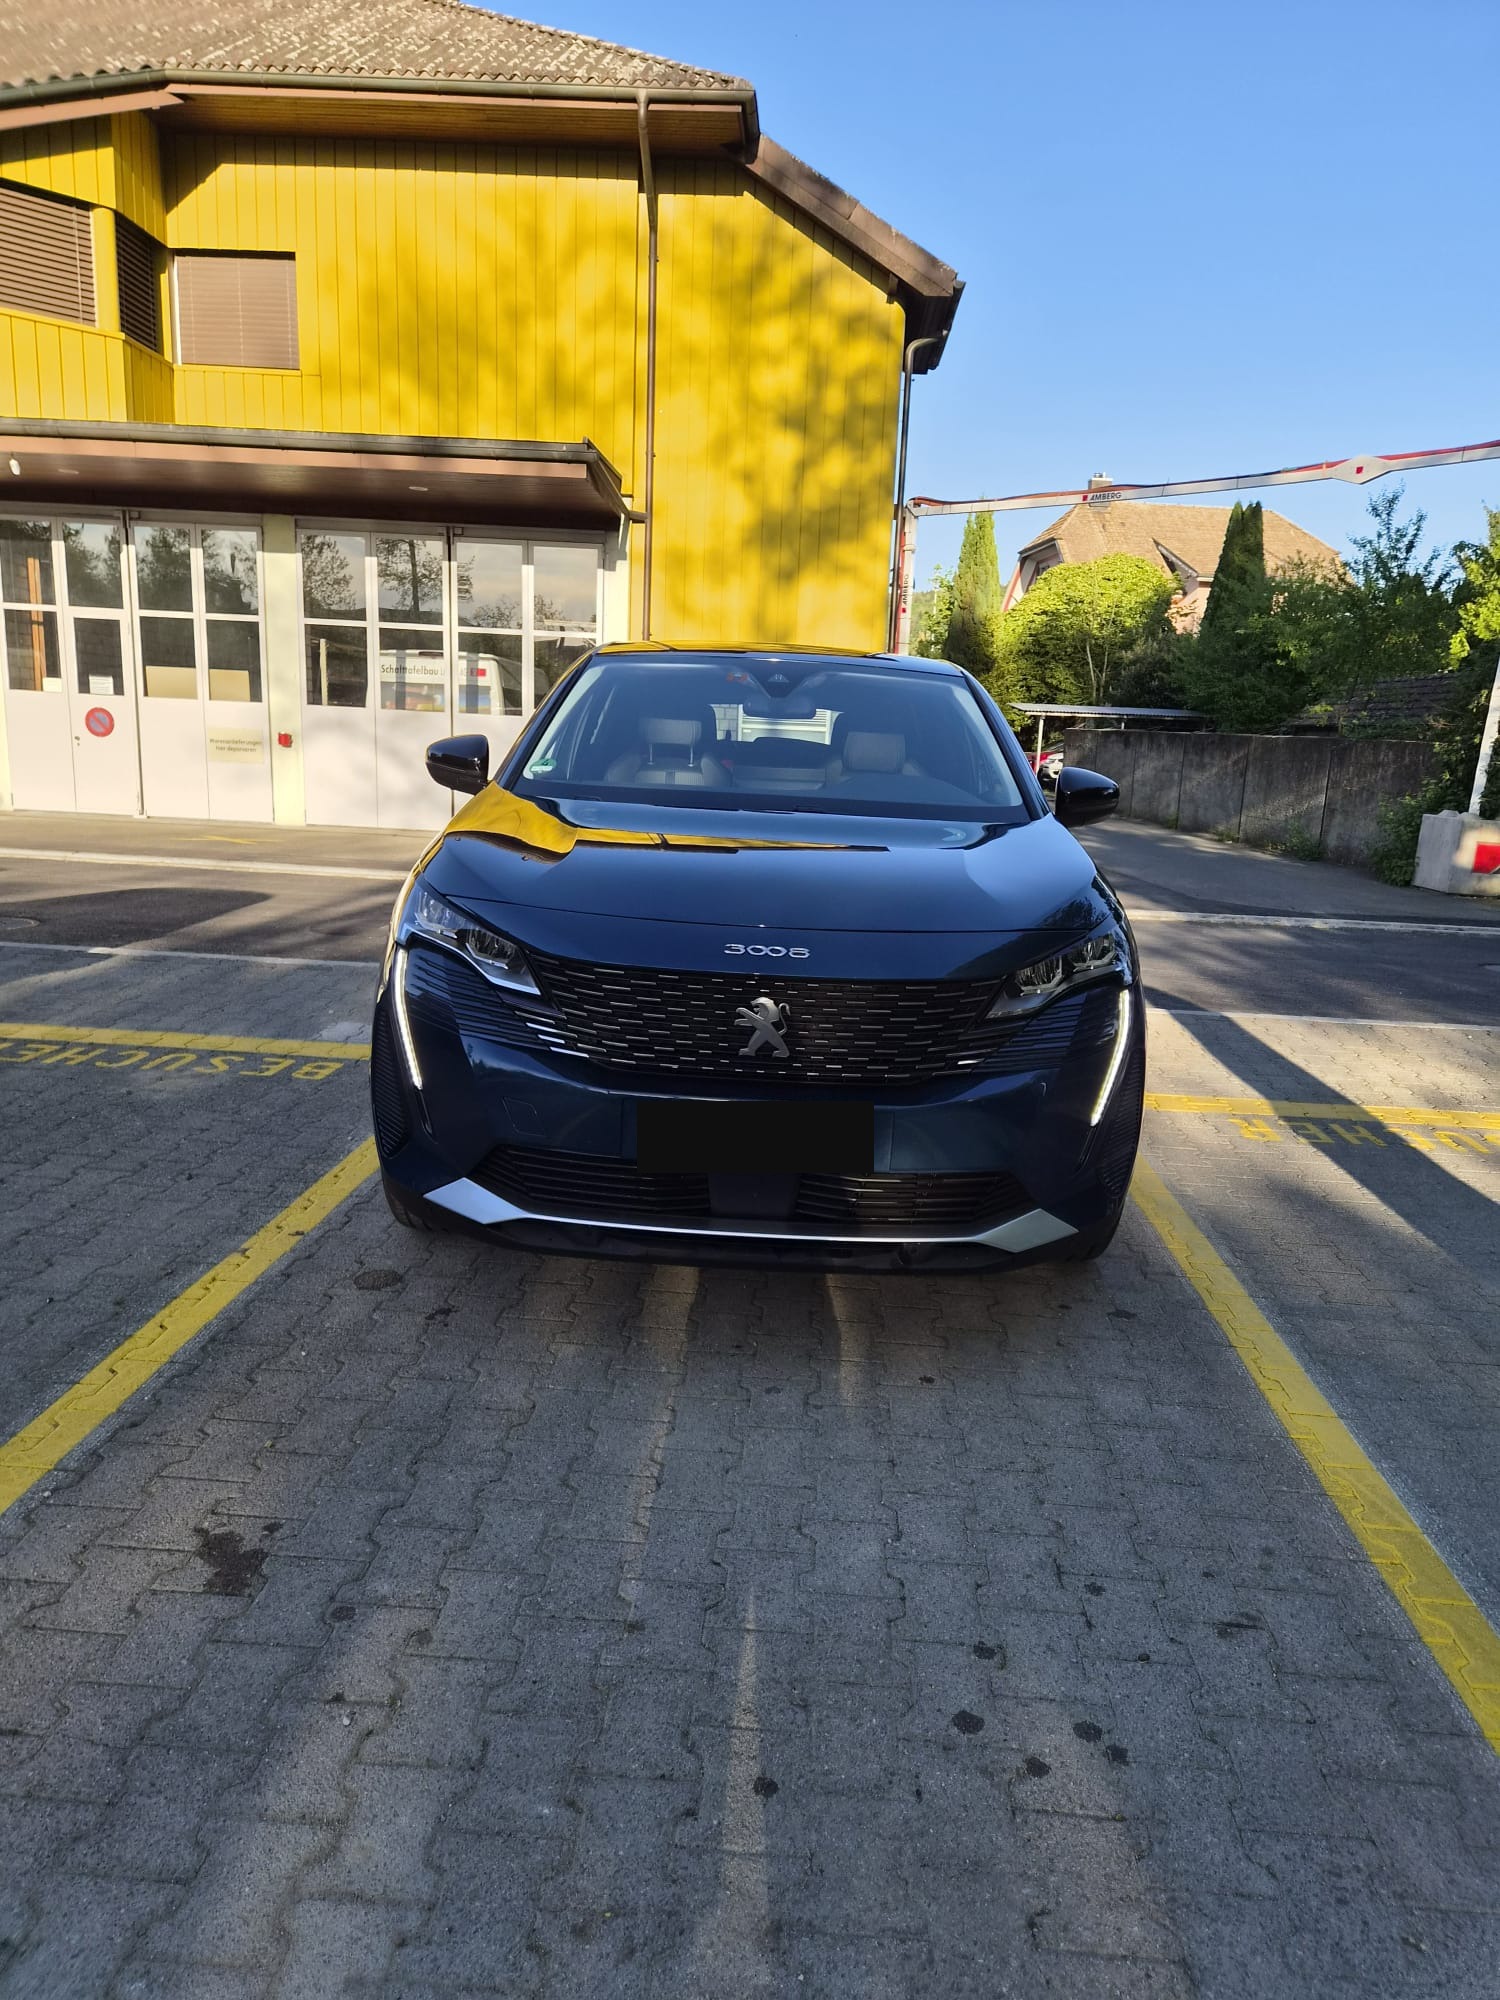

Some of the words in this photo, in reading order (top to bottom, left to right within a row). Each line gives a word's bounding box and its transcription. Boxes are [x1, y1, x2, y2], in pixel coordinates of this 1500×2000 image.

[1090, 492, 1122, 501] AMBERG
[902, 573, 910, 606] AMBERG
[723, 943, 811, 959] 3008
[0, 1042, 344, 1081] BESUCHE
